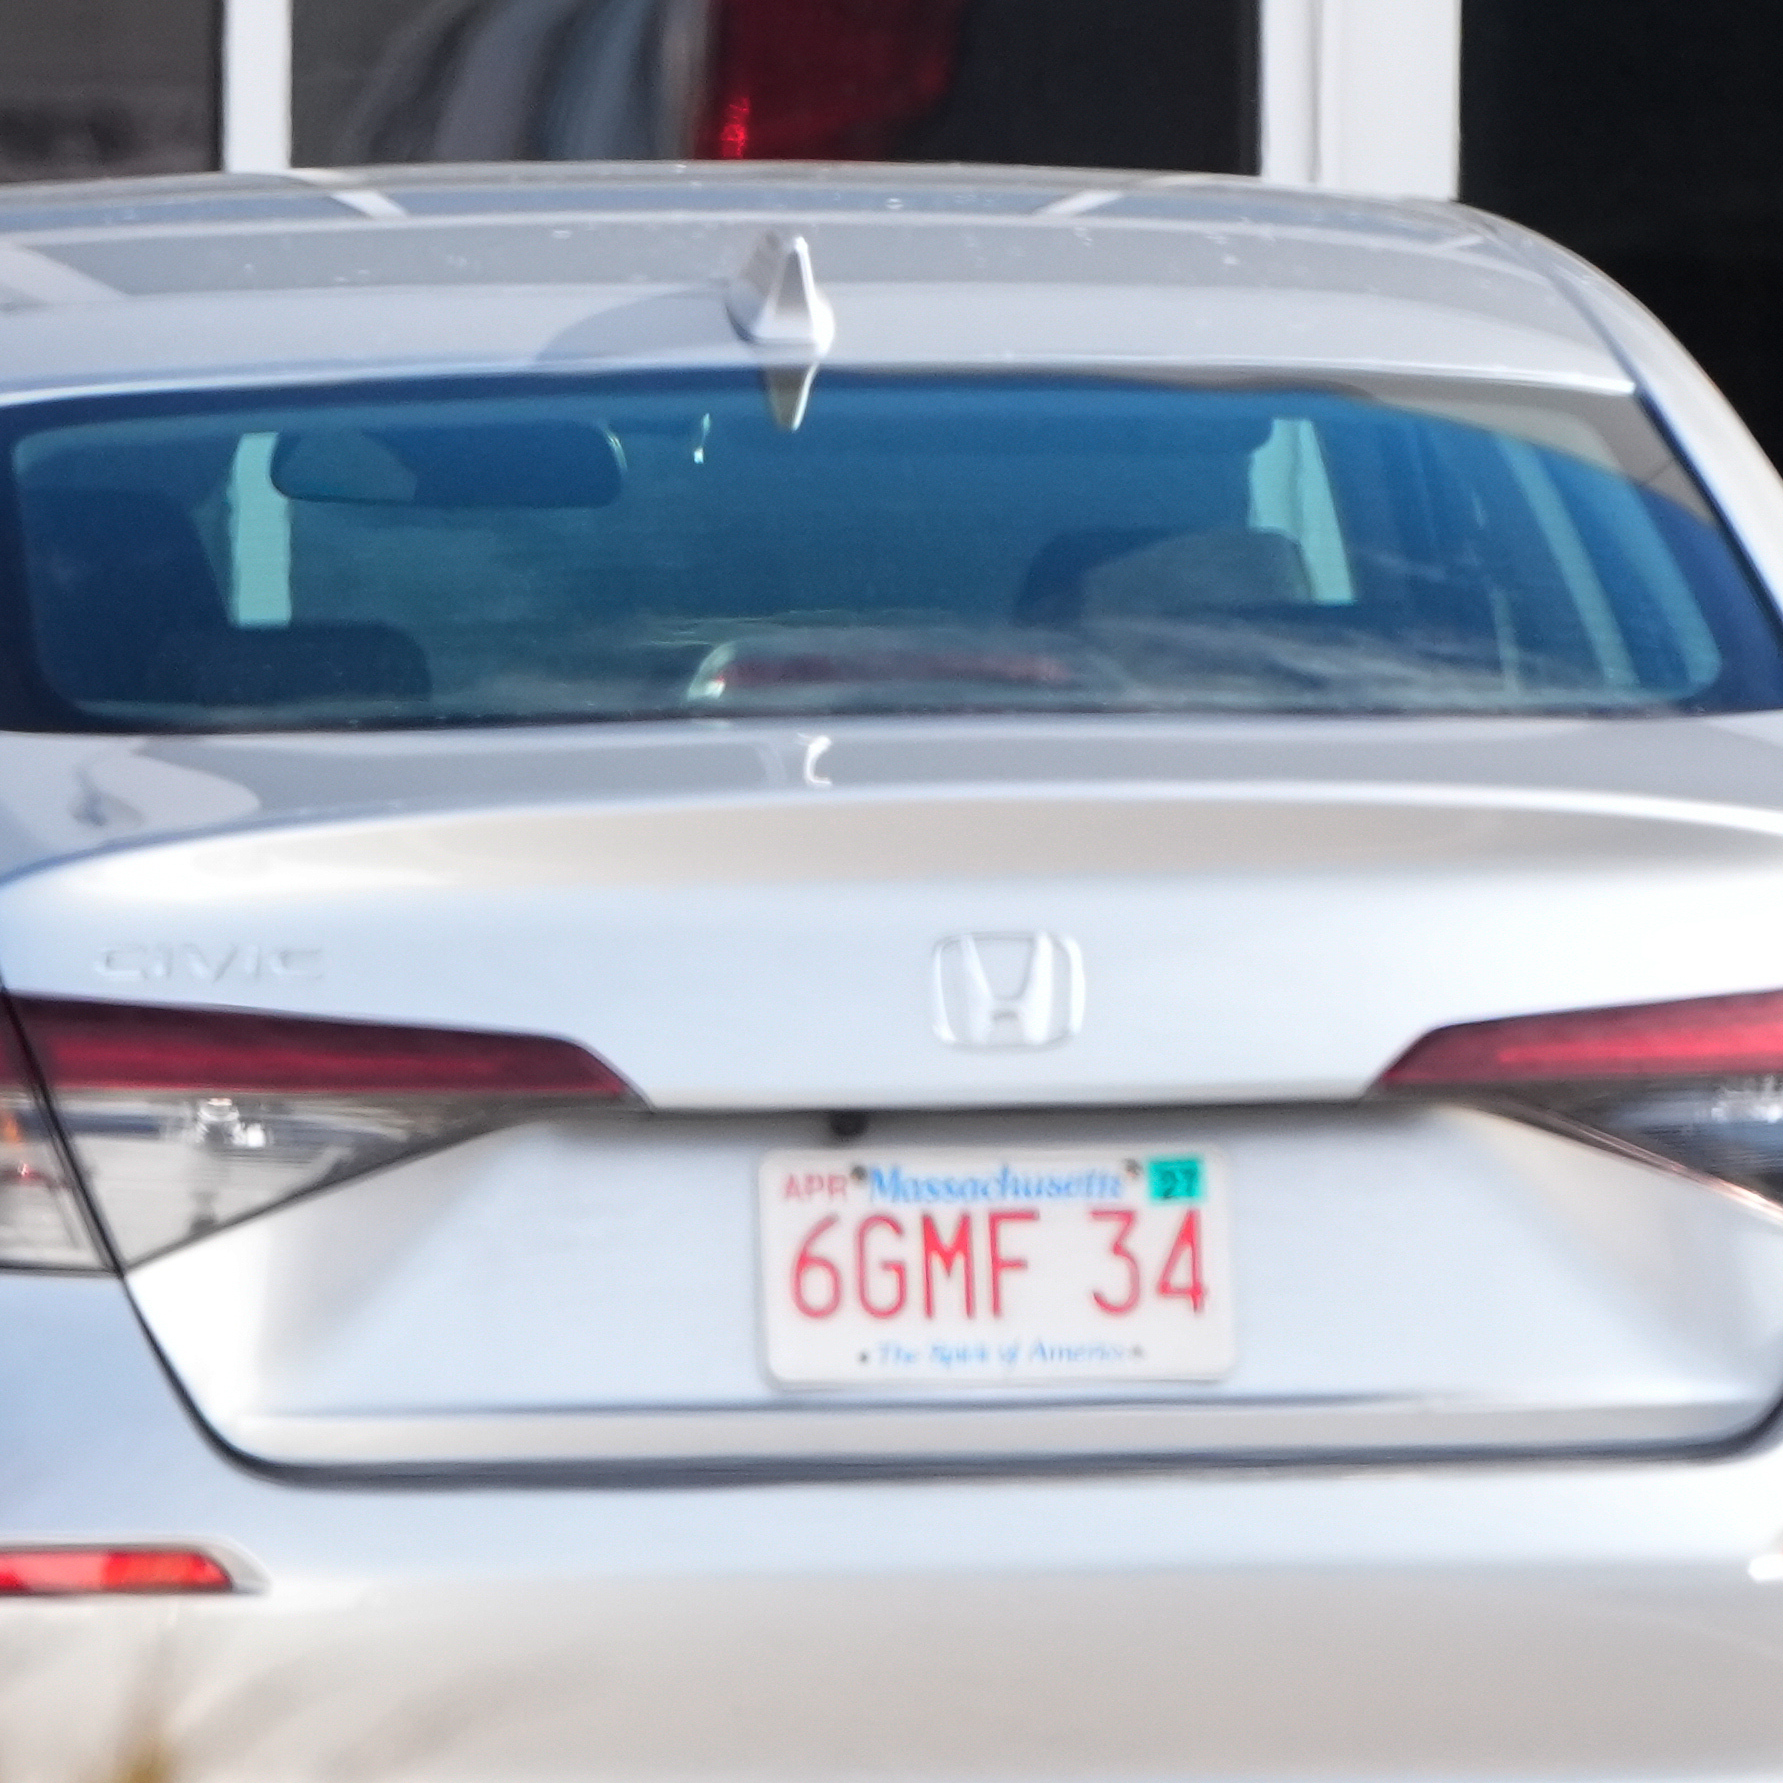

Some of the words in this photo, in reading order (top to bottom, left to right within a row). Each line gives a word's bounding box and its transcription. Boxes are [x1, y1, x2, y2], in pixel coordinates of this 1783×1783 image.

[94, 942, 325, 984] CIVIC
[782, 1172, 849, 1202] APR
[790, 1207, 1040, 1319] 6GMF
[1089, 1207, 1208, 1318] 34
